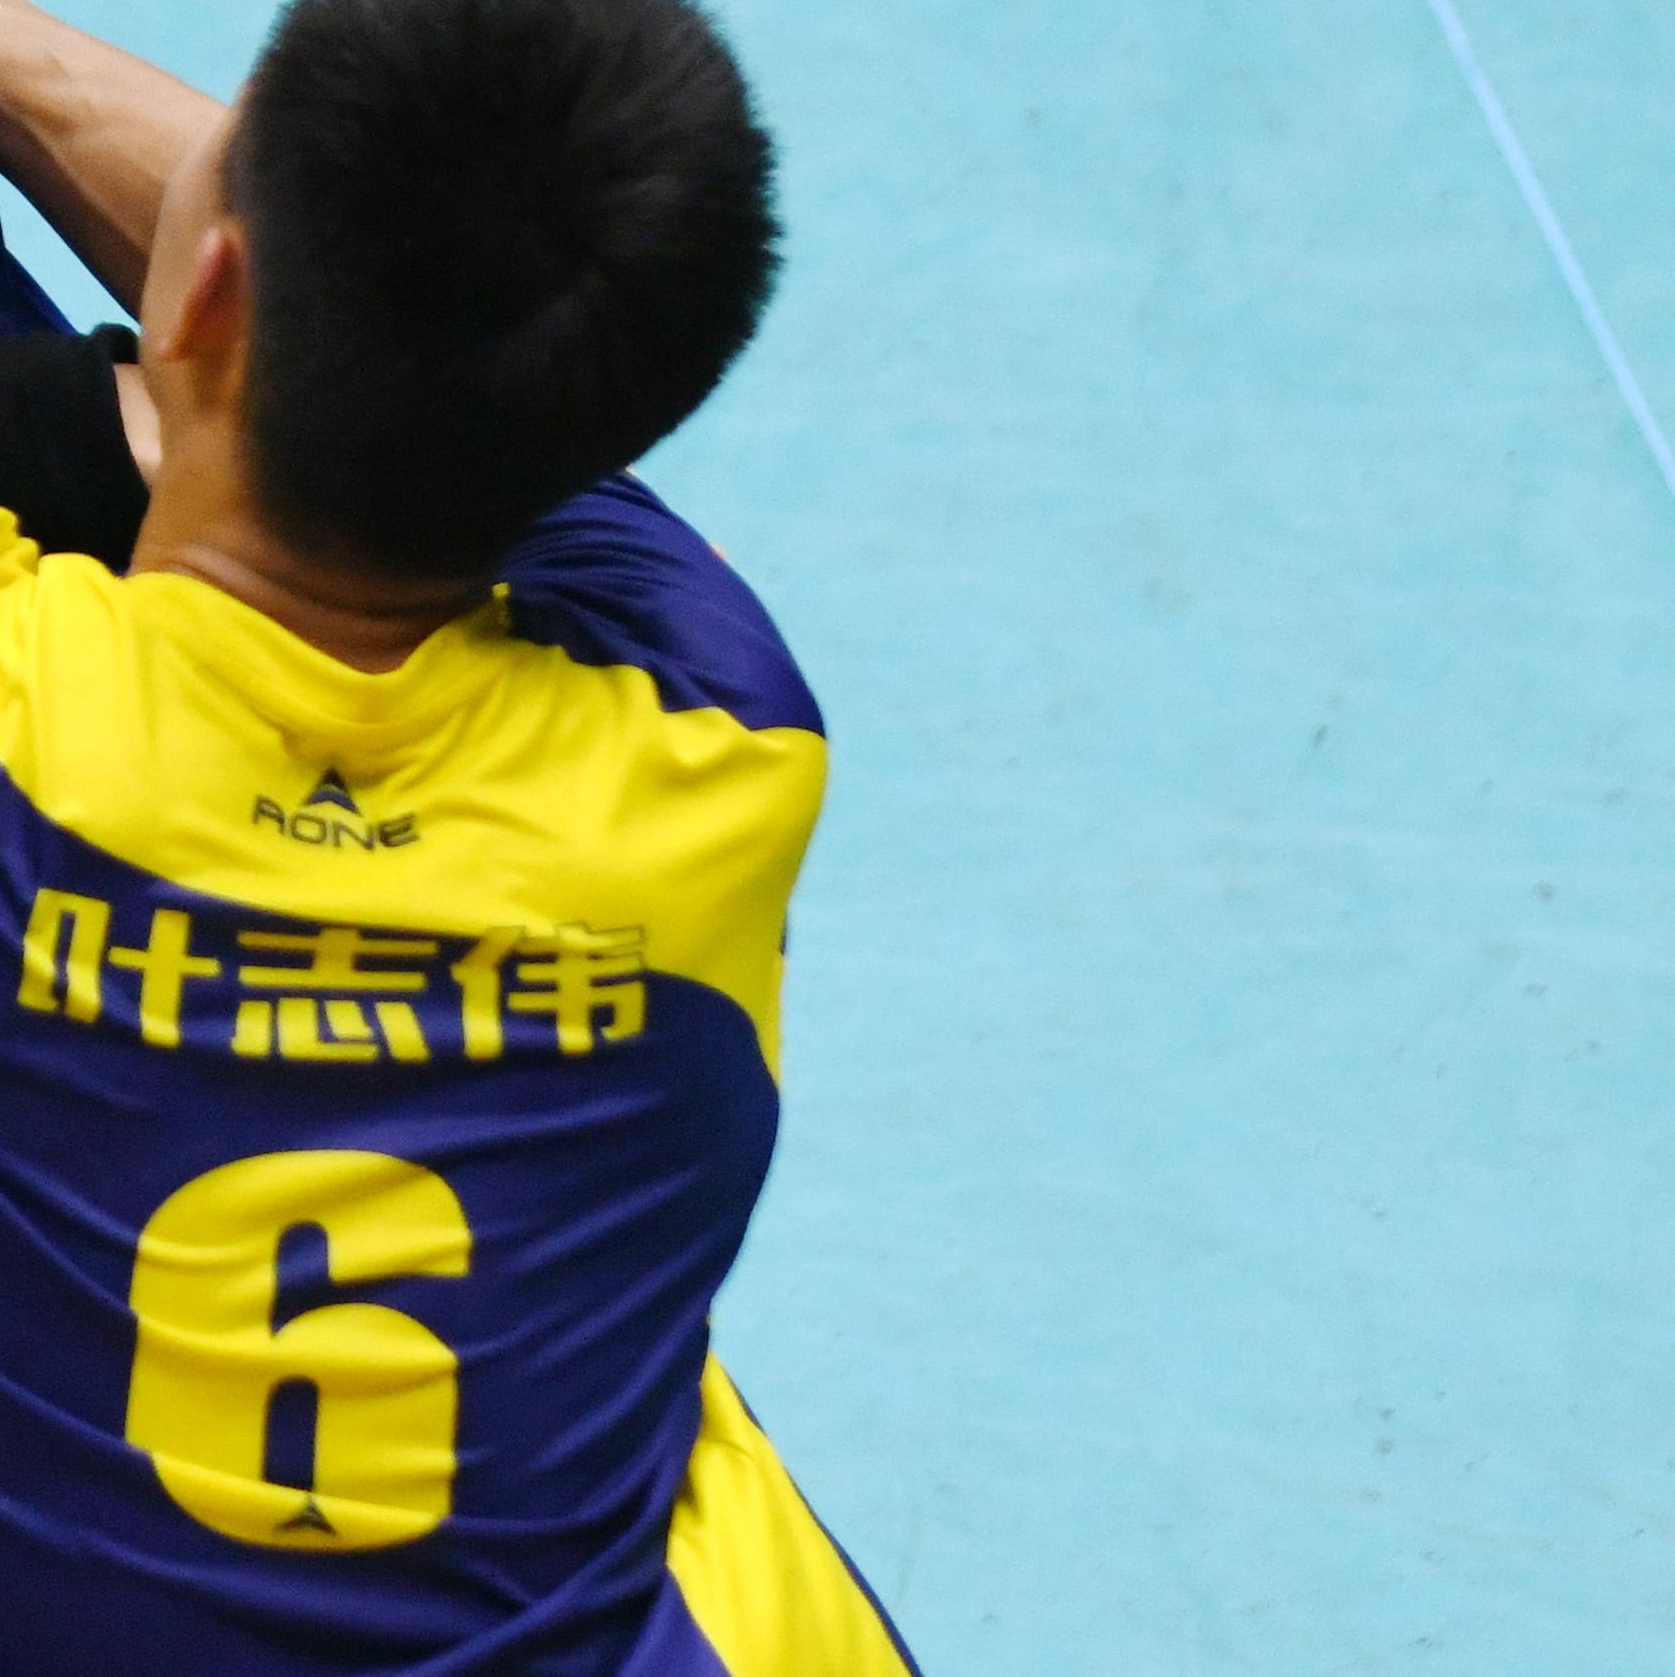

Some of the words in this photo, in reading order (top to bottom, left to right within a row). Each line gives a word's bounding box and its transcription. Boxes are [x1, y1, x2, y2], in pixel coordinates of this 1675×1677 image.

[16, 886, 647, 1063] 叶志伟
[123, 1148, 474, 1554] 6
